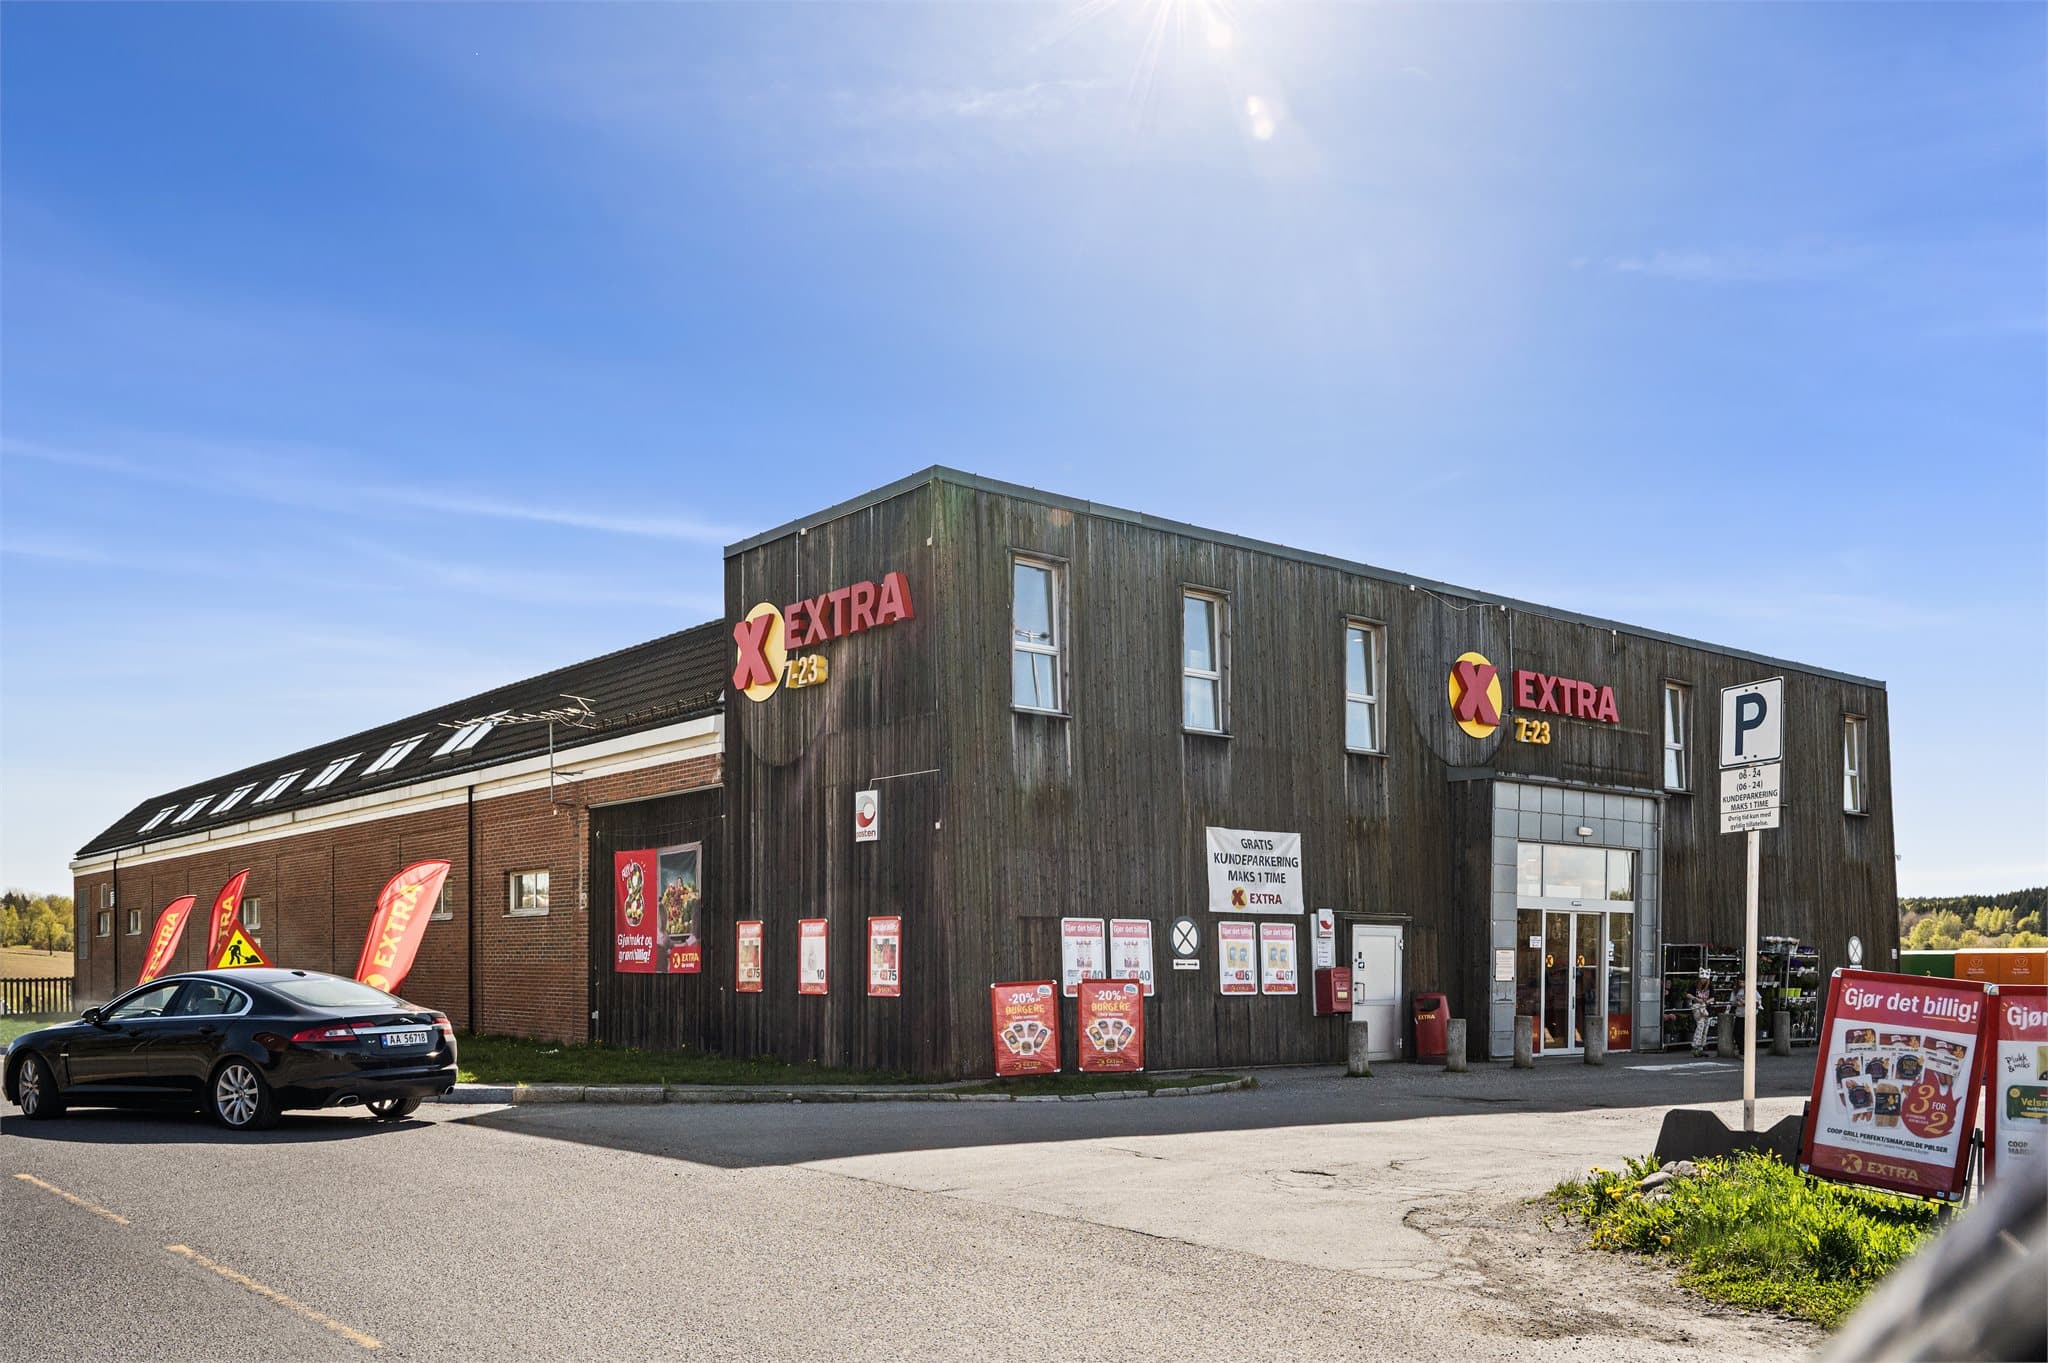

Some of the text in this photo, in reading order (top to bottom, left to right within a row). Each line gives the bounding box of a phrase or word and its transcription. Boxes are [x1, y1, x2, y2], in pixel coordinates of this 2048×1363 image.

[784, 571, 914, 650] EXTRA
[784, 654, 823, 688] 7-23
[1513, 669, 1620, 724] EXTRA
[1514, 716, 1551, 745] 7-23
[1734, 692, 1767, 756] P
[1752, 769, 1761, 778] 24
[1722, 789, 1778, 803] KUNDEPARKERING
[1731, 802, 1748, 811] MAKS
[1753, 800, 1769, 808] TIME
[1728, 814, 1741, 822] Øvrig
[1240, 838, 1274, 851] GRATIS
[1213, 852, 1299, 868] KUNDEPARKERING
[1228, 870, 1286, 884] MAKS 1 TIME
[1250, 893, 1283, 905] EXTRA
[372, 882, 423, 970] EXTRA
[149, 911, 180, 971] EXTRA
[681, 953, 699, 961] EXTRA
[817, 969, 825, 980] 10
[888, 969, 897, 981] 75
[1140, 970, 1151, 981] 40
[1009, 992, 1035, 1004] -20%
[1094, 990, 1122, 1001] -20%
[1005, 1004, 1045, 1015] BURGERE
[1091, 1001, 1131, 1011] BURGERE
[1844, 987, 1979, 1023] Gjør det billig!
[2006, 1004, 2048, 1031] Gjør
[390, 1033, 401, 1045] AA
[404, 1032, 426, 1044] 56718
[1910, 1084, 1935, 1114] 3
[1931, 1101, 1947, 1112] FOR
[1923, 1112, 1949, 1135] 2
[1827, 1127, 1843, 1135] COOP
[1843, 1129, 1859, 1138] GRILL
[1924, 1143, 1948, 1153] PØLSER
[1866, 1161, 1919, 1181] EXTRA
